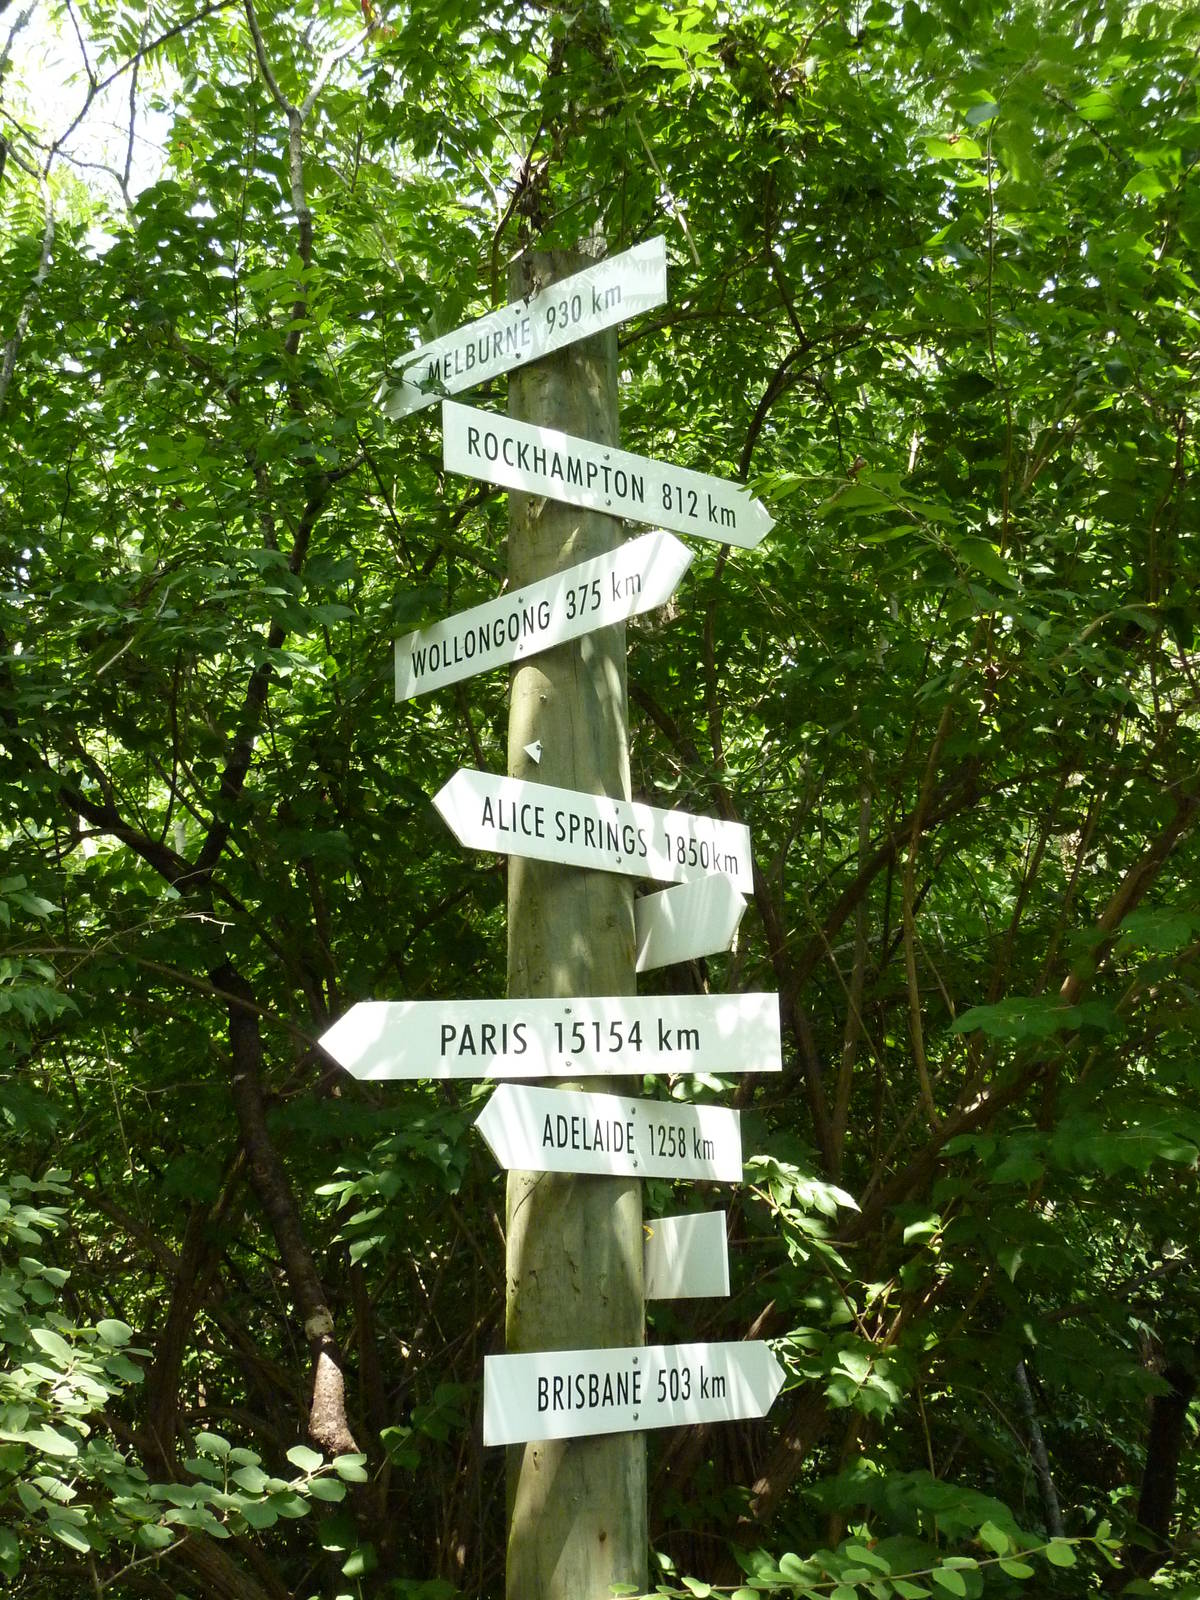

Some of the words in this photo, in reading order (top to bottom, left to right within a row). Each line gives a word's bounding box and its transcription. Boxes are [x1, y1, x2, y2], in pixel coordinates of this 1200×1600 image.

[428, 317, 531, 381] MELBURNE
[546, 294, 582, 335] 930
[592, 283, 622, 314] km
[468, 427, 644, 503] ROCKHAMPTON
[662, 483, 698, 519] 812
[708, 494, 736, 528] km
[411, 601, 550, 678] WOLLONGONG
[566, 580, 601, 620] 375
[611, 571, 641, 602] km
[481, 796, 545, 839] ALICE
[555, 811, 647, 857] SPRINGS
[440, 1022, 528, 1056] PARIS
[554, 1021, 643, 1054] 15154
[658, 1018, 700, 1051] km
[542, 1114, 635, 1155] ADELAIDE
[648, 1124, 687, 1158] 1258
[693, 1128, 715, 1161] km
[537, 1371, 642, 1412] BRISBANE
[657, 1367, 691, 1401] 503
[700, 1366, 726, 1399] km
